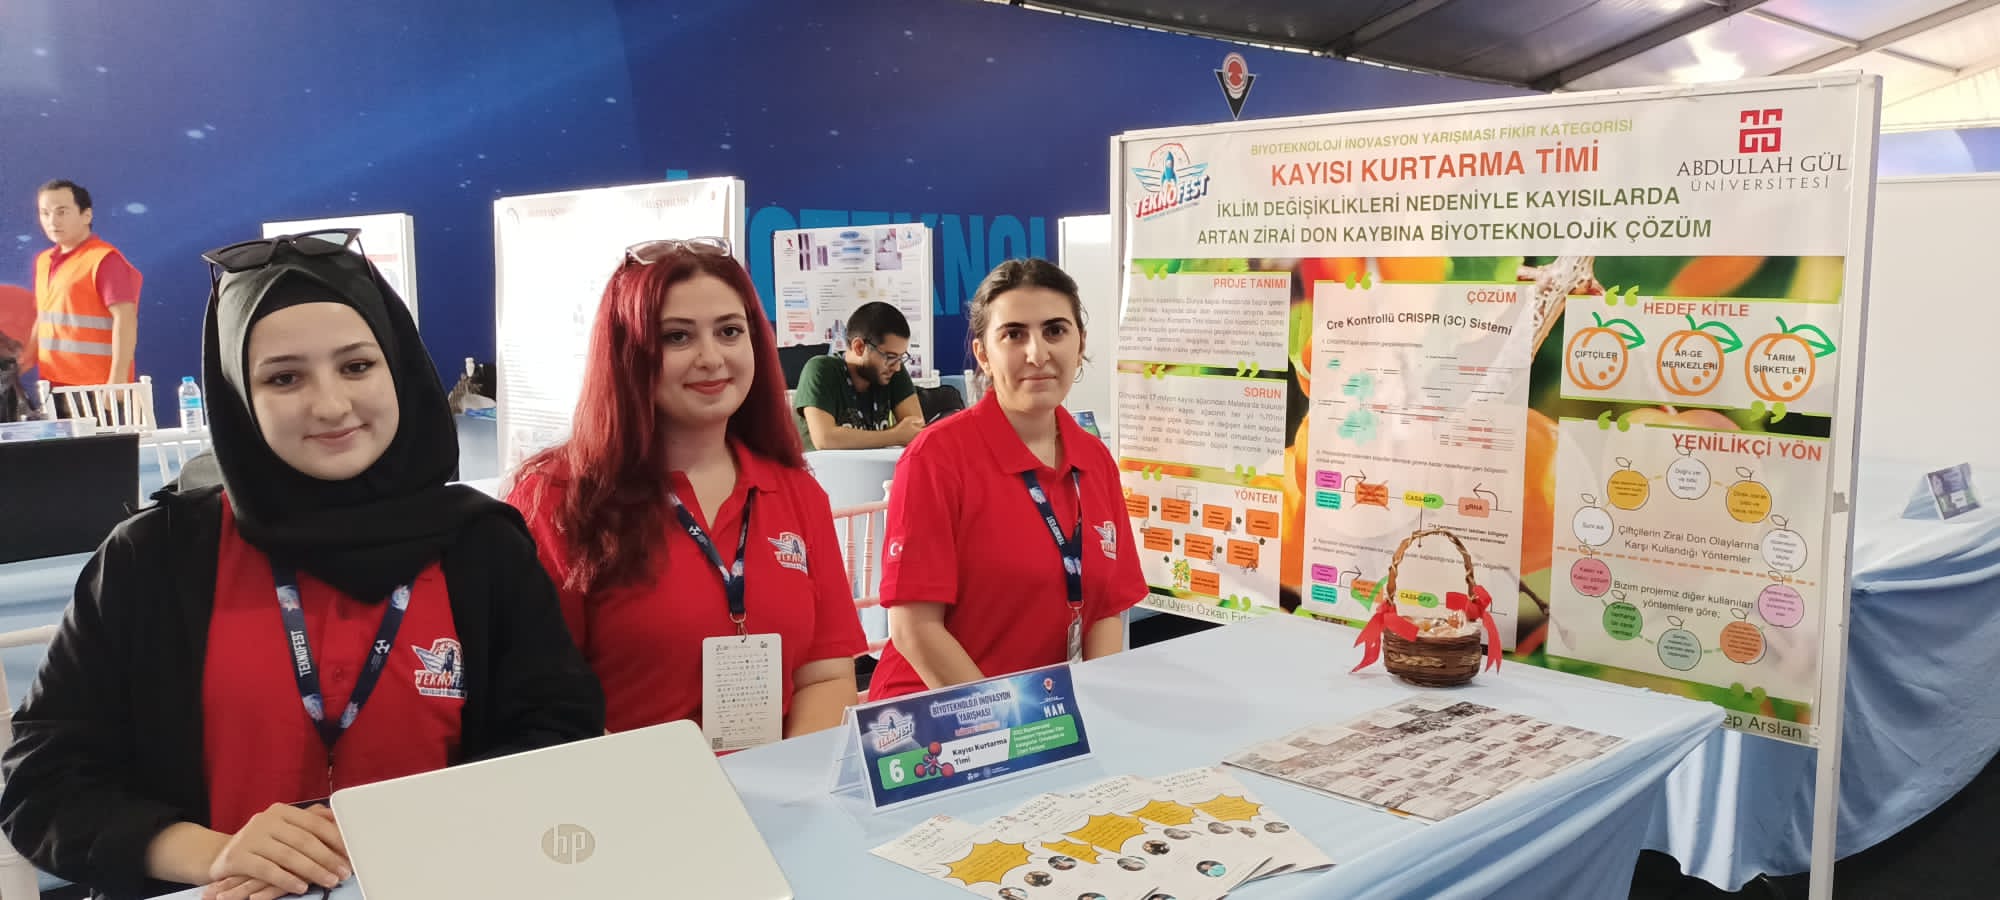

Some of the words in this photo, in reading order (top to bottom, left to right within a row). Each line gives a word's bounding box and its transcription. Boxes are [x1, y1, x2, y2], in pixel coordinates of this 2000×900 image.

[1422, 128, 1495, 145] YARIŞMASI
[1271, 160, 1352, 187] KAYISI
[1361, 150, 1526, 182] KURTARMA
[1535, 139, 1600, 175] TİMİ
[1676, 156, 1793, 177] ABDULLAH
[1800, 151, 1848, 173] GÜL
[1690, 174, 1829, 192] ÜNİVERSİTESİ
[1135, 175, 1211, 219] TEKNOFEST
[1216, 199, 1259, 218] İKLİM
[1263, 192, 1400, 220] DEĞİŞİKLİKLERİ
[1406, 190, 1519, 212] NEDENİYLE
[1526, 186, 1680, 209] KAYISILARDA
[1198, 229, 1249, 245] ARTAN
[1253, 224, 1295, 244] ZİRAİ
[1301, 227, 1337, 243] DON
[1343, 224, 1425, 243] KAYBINA
[1431, 217, 1617, 241] BİYOTEKNOLOJİK
[1625, 215, 1712, 243] ÇÖZÜM
[1213, 278, 1247, 289] PROJE
[1250, 278, 1287, 289] TANIMI
[1466, 289, 1517, 305] ÇÖZÜM
[1643, 302, 1697, 316] HEDEF
[1701, 300, 1750, 317] KİTLE
[1326, 319, 1344, 331] Cre
[1346, 312, 1395, 327] Kontrollü
[1398, 312, 1440, 324] CRISPR
[1443, 315, 1466, 329] (3C)
[1469, 317, 1513, 337] Sistemi
[1674, 349, 1703, 359] AR-GE
[1767, 353, 1796, 362] TARIM
[1243, 387, 1282, 400] SORUN
[1671, 431, 1773, 458] YENİLİKÇİ
[1777, 440, 1823, 462] YÖN
[1234, 488, 1278, 505] YÖNTEM
[1618, 524, 1662, 541] Çiftçilerin
[1663, 529, 1684, 542] Zirai
[1686, 533, 1707, 545] Don
[1708, 535, 1760, 552] Olaylarına
[1624, 540, 1650, 554] Karşı
[1651, 541, 1698, 560] Kullandığı
[1701, 548, 1752, 564] Yöntemler
[1613, 579, 1639, 593] Bizim
[1640, 584, 1680, 600] projemiz
[1682, 589, 1706, 603] diğer
[1707, 593, 1754, 610] kullanılan
[1642, 598, 1694, 615] yöntemlere
[290, 630, 312, 678] TEKNOFEST
[1748, 715, 1802, 739] Arslan
[889, 758, 905, 784] 6
[551, 823, 587, 865] hp
